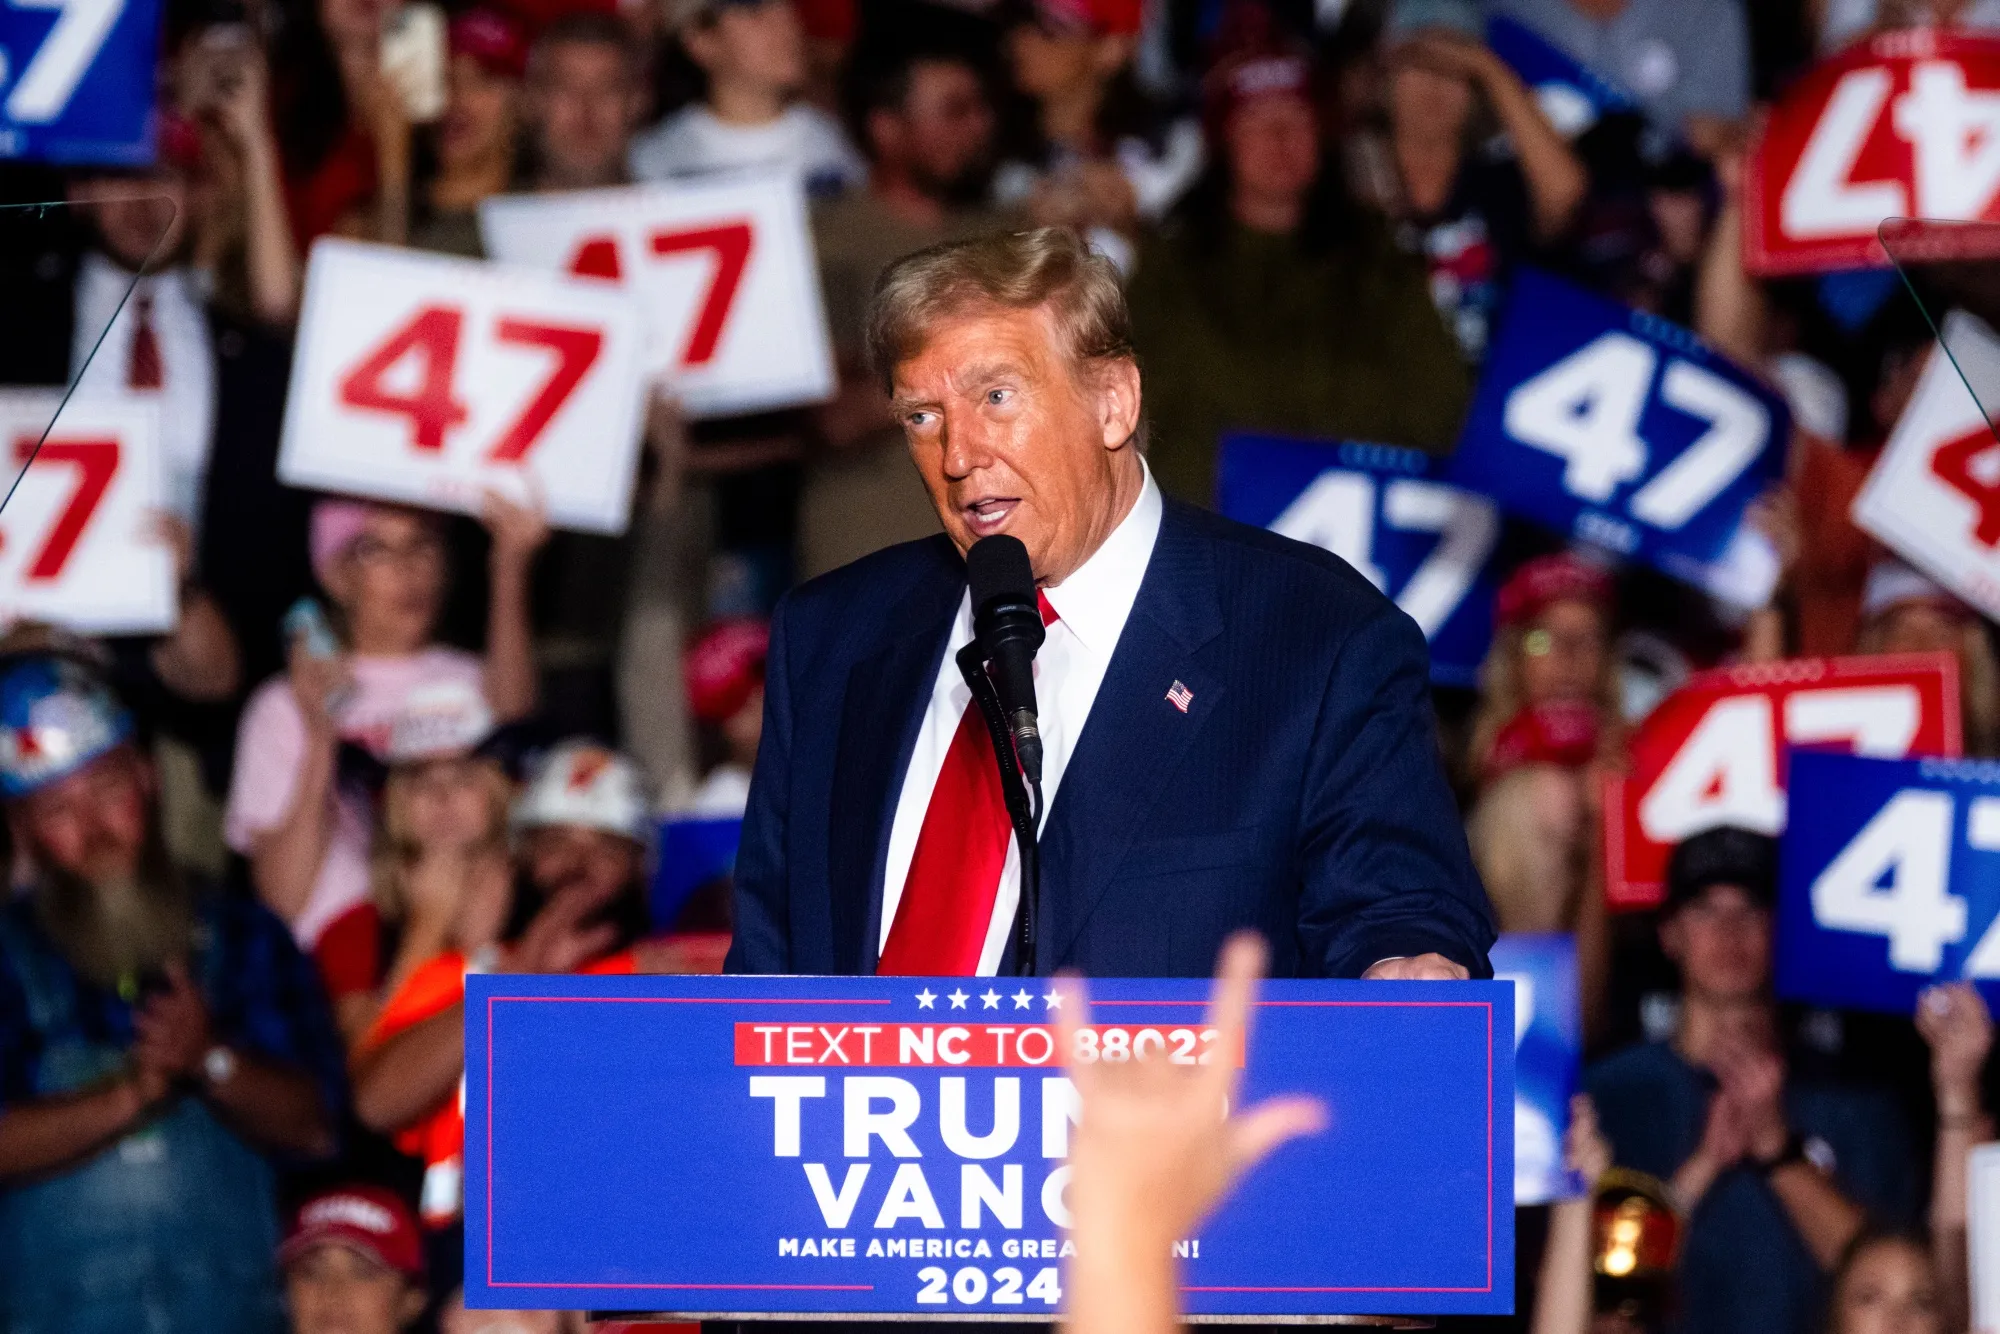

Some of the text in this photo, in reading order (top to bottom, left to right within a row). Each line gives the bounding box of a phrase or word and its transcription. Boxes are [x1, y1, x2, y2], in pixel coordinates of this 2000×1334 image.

[0, 0, 127, 123] 7
[1779, 61, 2000, 241] 47
[566, 217, 757, 366] 7
[335, 304, 607, 464] 47
[1503, 332, 1771, 530] 47
[754, 1027, 882, 1063] TEXT
[899, 1027, 971, 1065] NC
[986, 1027, 1054, 1065] TO
[778, 1238, 856, 1257] MAKE
[865, 1238, 992, 1258] AMERICA
[916, 1266, 1062, 1305] 2024
